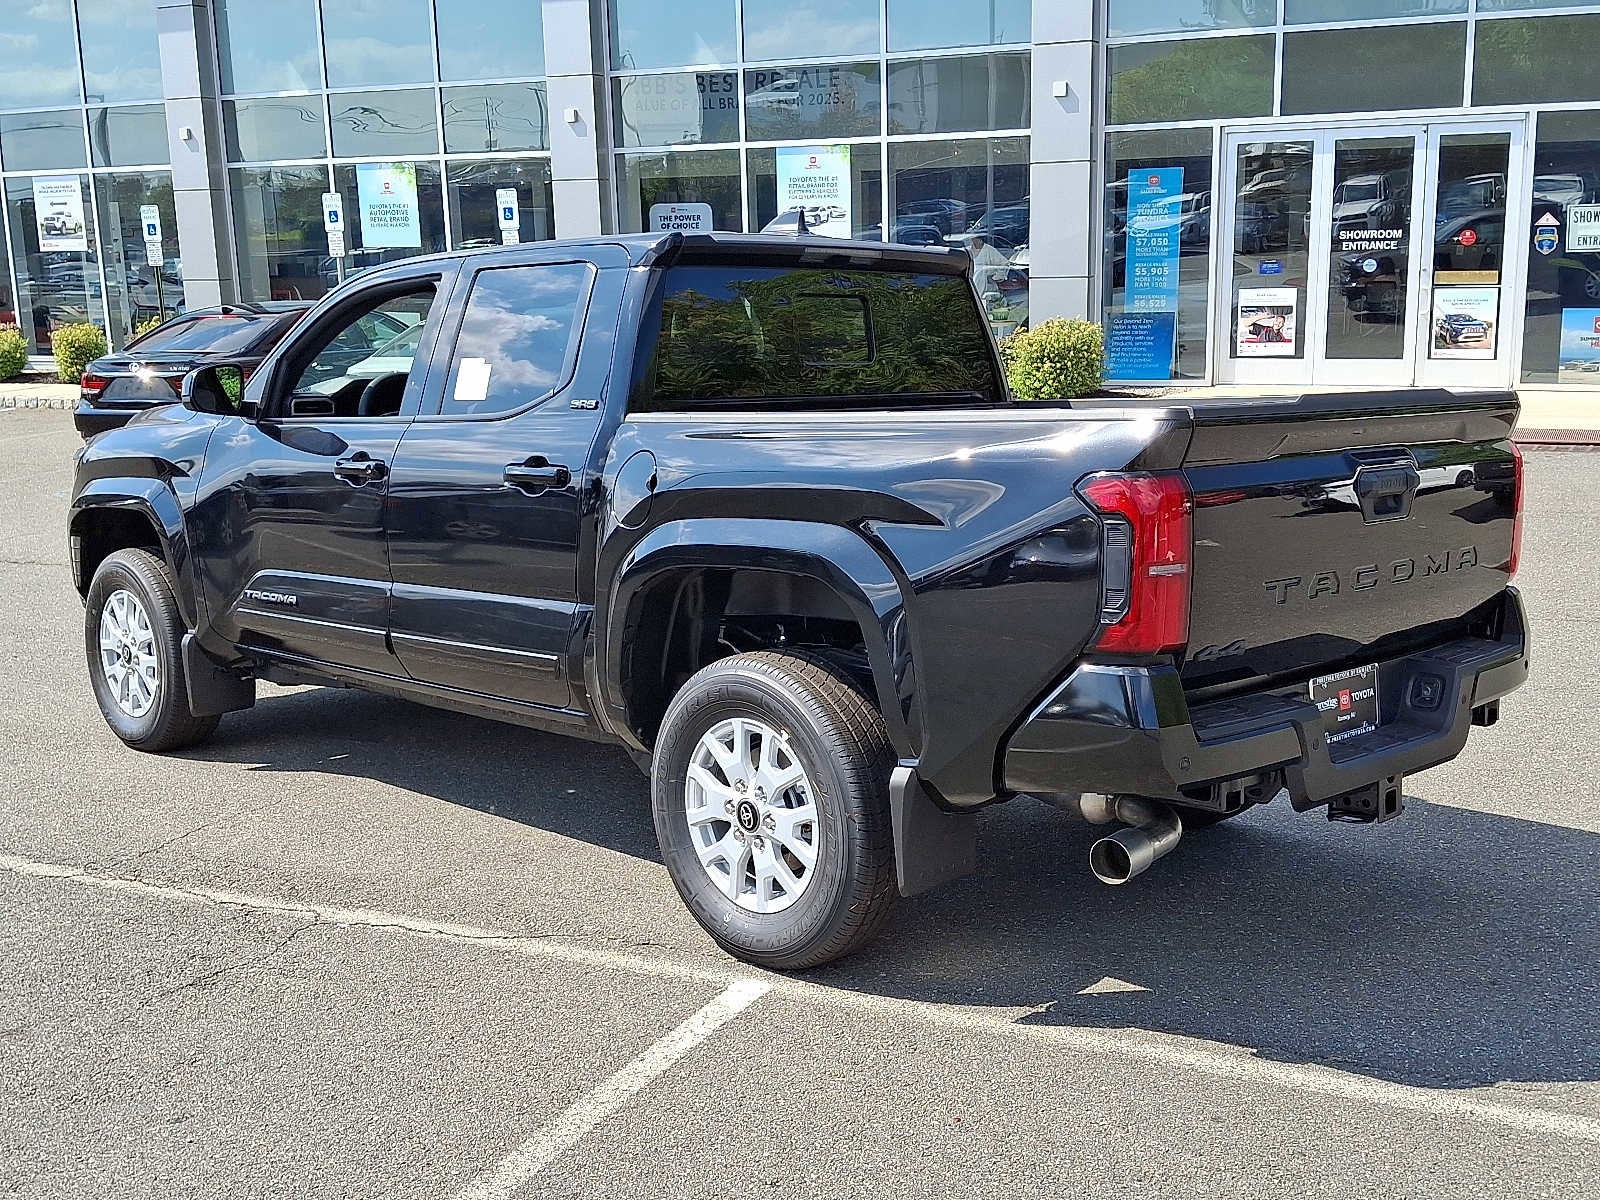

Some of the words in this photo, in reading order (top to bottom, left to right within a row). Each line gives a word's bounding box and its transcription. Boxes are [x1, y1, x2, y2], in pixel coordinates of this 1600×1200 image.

[674, 214, 701, 222] POWER
[660, 222, 671, 230] OF
[671, 222, 700, 230] CHOICE
[1338, 229, 1403, 240] SHOWROOM
[1135, 237, 1168, 247] $7,050
[1342, 240, 1399, 251] ENTRANCE
[1135, 267, 1169, 277] $5,905
[1262, 544, 1479, 605] TACOMA
[244, 588, 298, 605] TACOMA
[1351, 688, 1375, 702] TOYOTA
